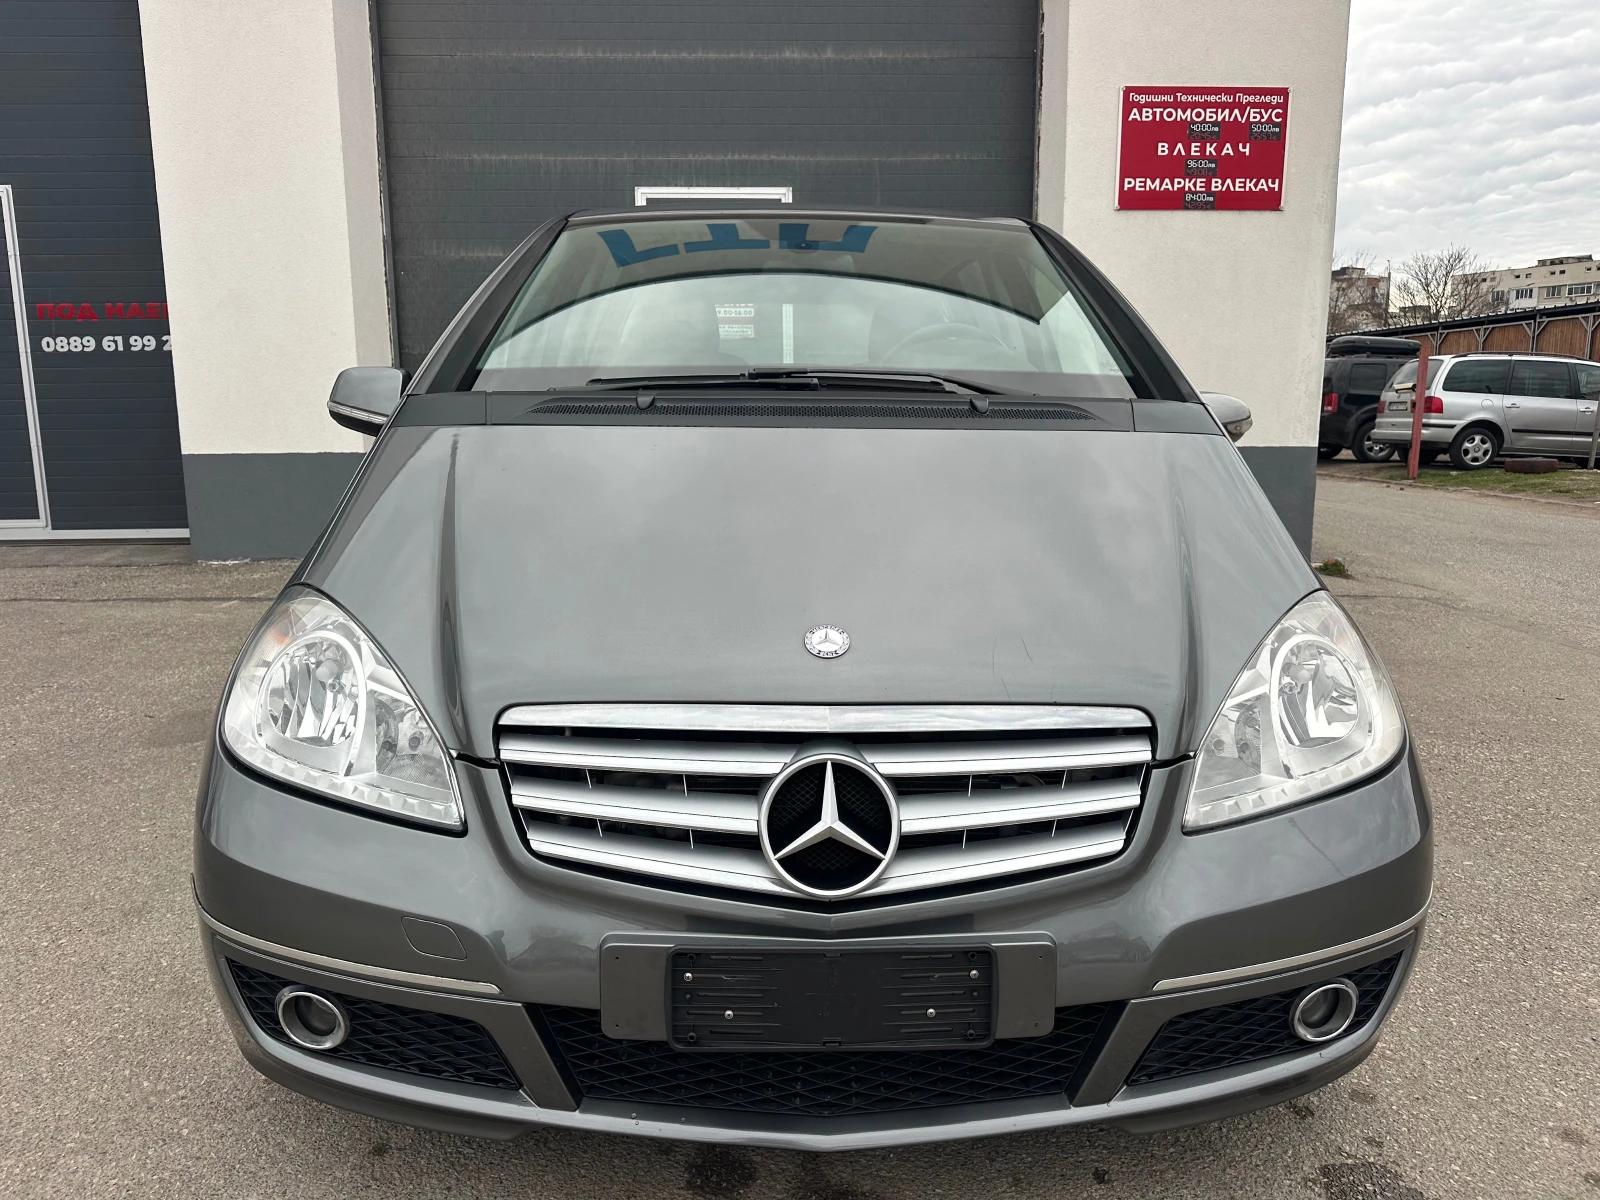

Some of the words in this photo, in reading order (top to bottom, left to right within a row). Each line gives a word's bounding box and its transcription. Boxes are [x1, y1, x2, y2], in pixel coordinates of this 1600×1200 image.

[1129, 92, 1174, 104] Годишни
[1176, 93, 1233, 103] Технически
[1236, 93, 1284, 105] Прегледи
[1128, 107, 1283, 124] АВТОМОБИЛ/БУС
[1123, 178, 1206, 192] РЕМАРКЕ
[1211, 178, 1279, 192] ВЛЕКАЧ
[36, 302, 99, 323] ПОД
[41, 336, 96, 353] 0889
[101, 335, 124, 352] 61
[129, 335, 156, 352] 99
